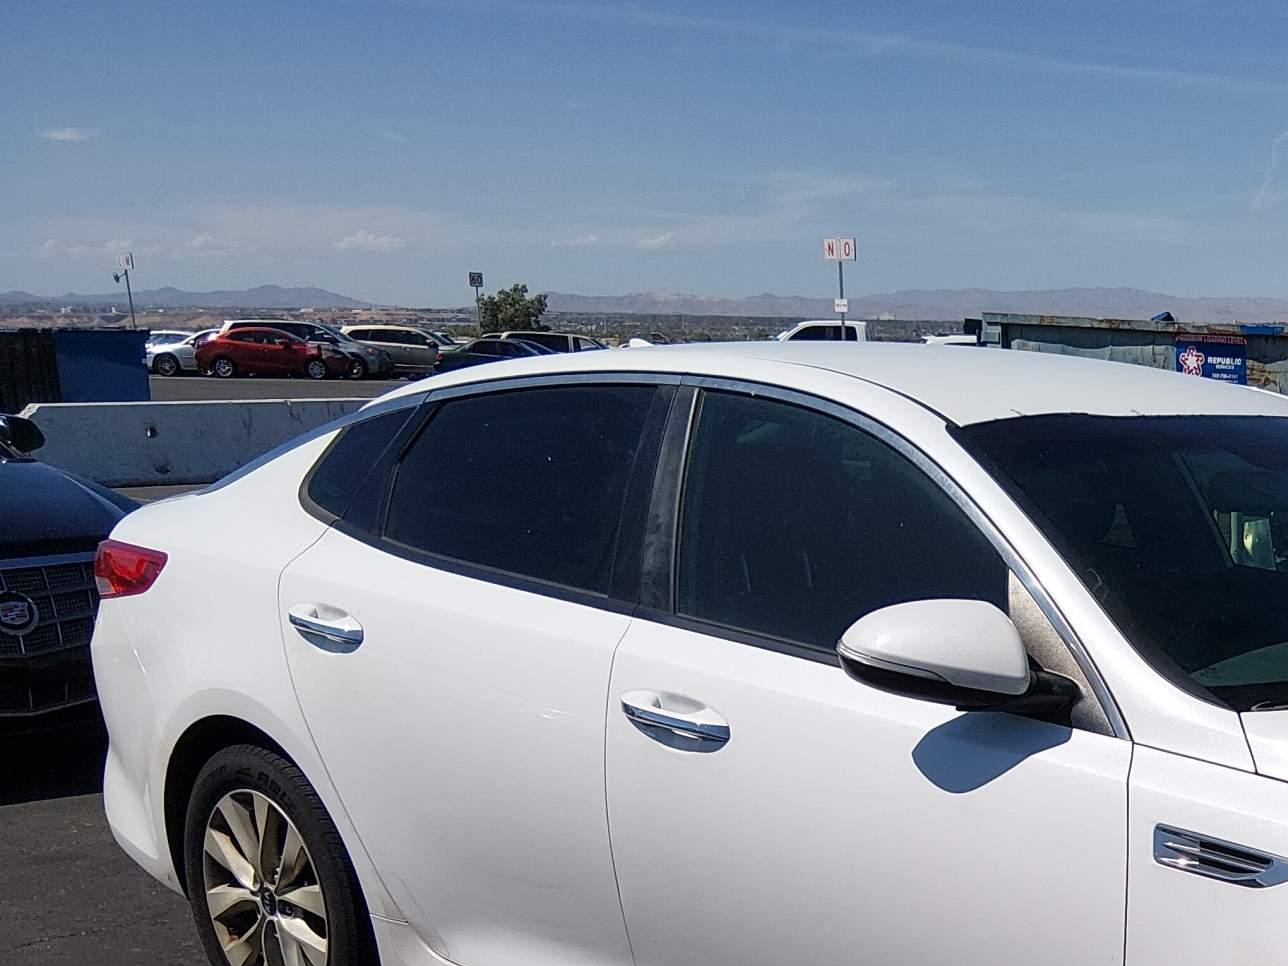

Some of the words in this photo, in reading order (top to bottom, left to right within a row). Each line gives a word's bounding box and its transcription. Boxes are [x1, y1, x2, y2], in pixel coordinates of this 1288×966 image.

[827, 242, 835, 257] N
[844, 242, 851, 257] O
[1207, 356, 1242, 366] REPUBLIC
